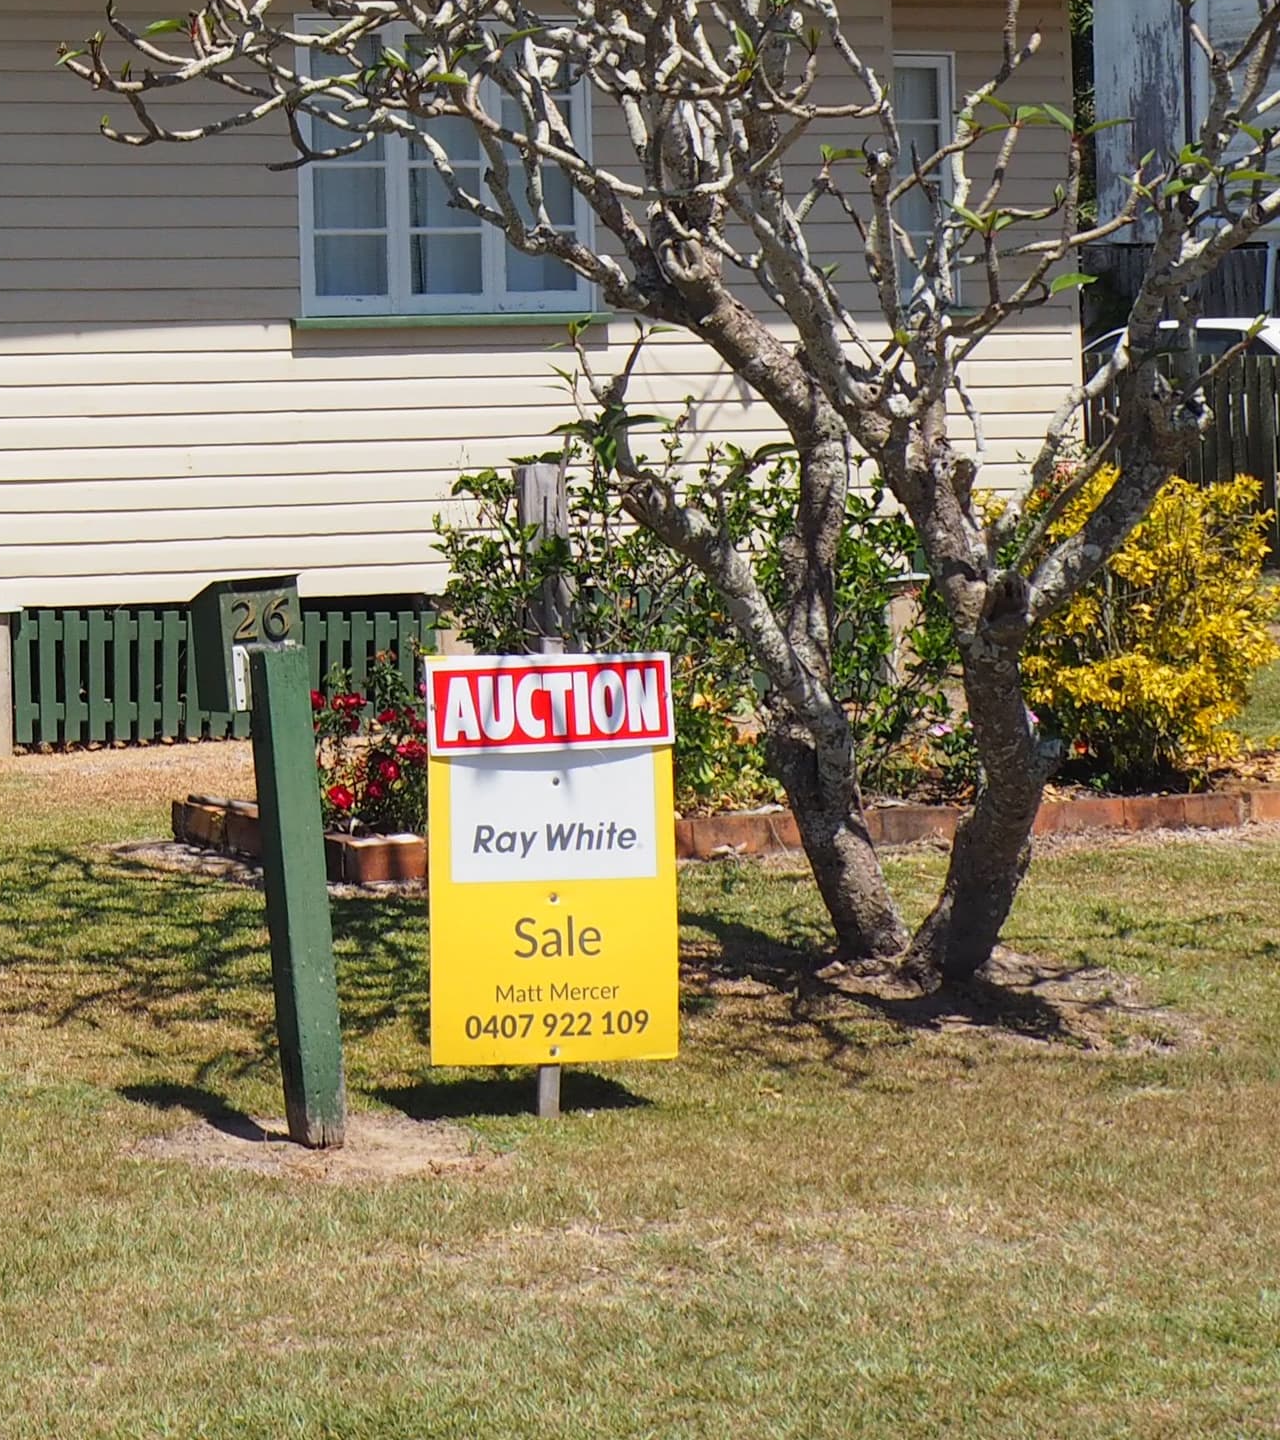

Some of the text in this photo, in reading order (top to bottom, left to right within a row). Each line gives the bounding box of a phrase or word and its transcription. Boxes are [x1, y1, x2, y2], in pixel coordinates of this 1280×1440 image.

[231, 597, 290, 643] 26
[443, 667, 661, 742] AUCTION
[473, 821, 637, 858] Ray White
[514, 915, 602, 958] Sale
[495, 982, 620, 1003] Matt Mercer
[465, 1009, 650, 1039] 0407 922 109
